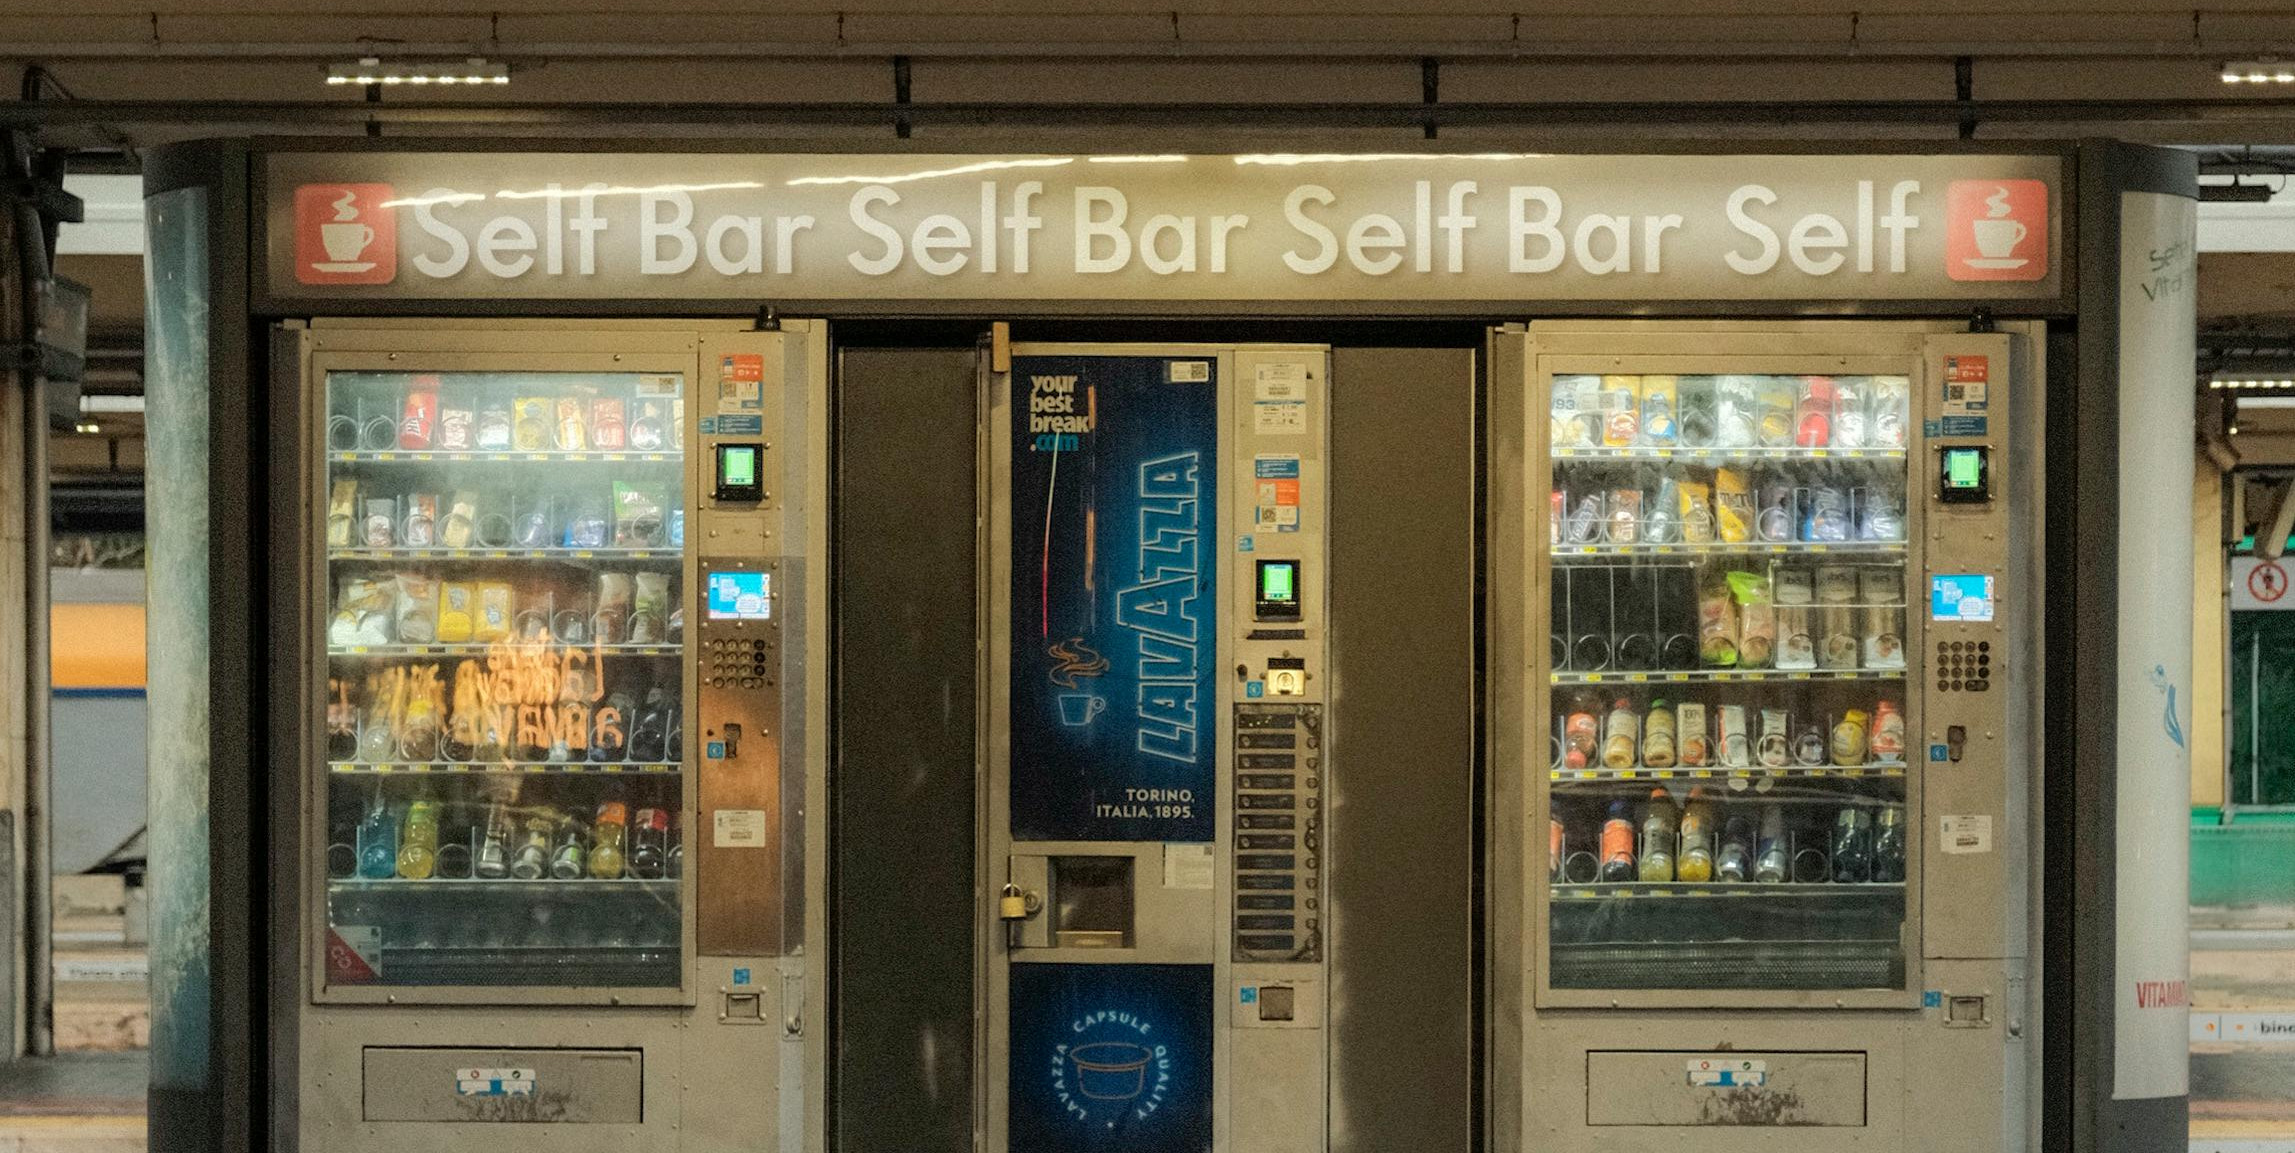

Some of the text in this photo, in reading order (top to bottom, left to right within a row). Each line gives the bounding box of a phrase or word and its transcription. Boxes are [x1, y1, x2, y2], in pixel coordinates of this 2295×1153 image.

[411, 180, 1919, 279] Self Bar Self Bar Self Bar Self
[1030, 375, 1078, 397] your
[1030, 394, 1074, 413] best
[1030, 413, 1089, 433] break
[1030, 434, 1079, 452] .com
[1117, 452, 1199, 763] LAVAZZA
[1125, 788, 1195, 803] TORINO,
[1154, 805, 1195, 819] 1895.
[1052, 1011, 1170, 1120] LAVAZZA CAPSULE QUALITY
